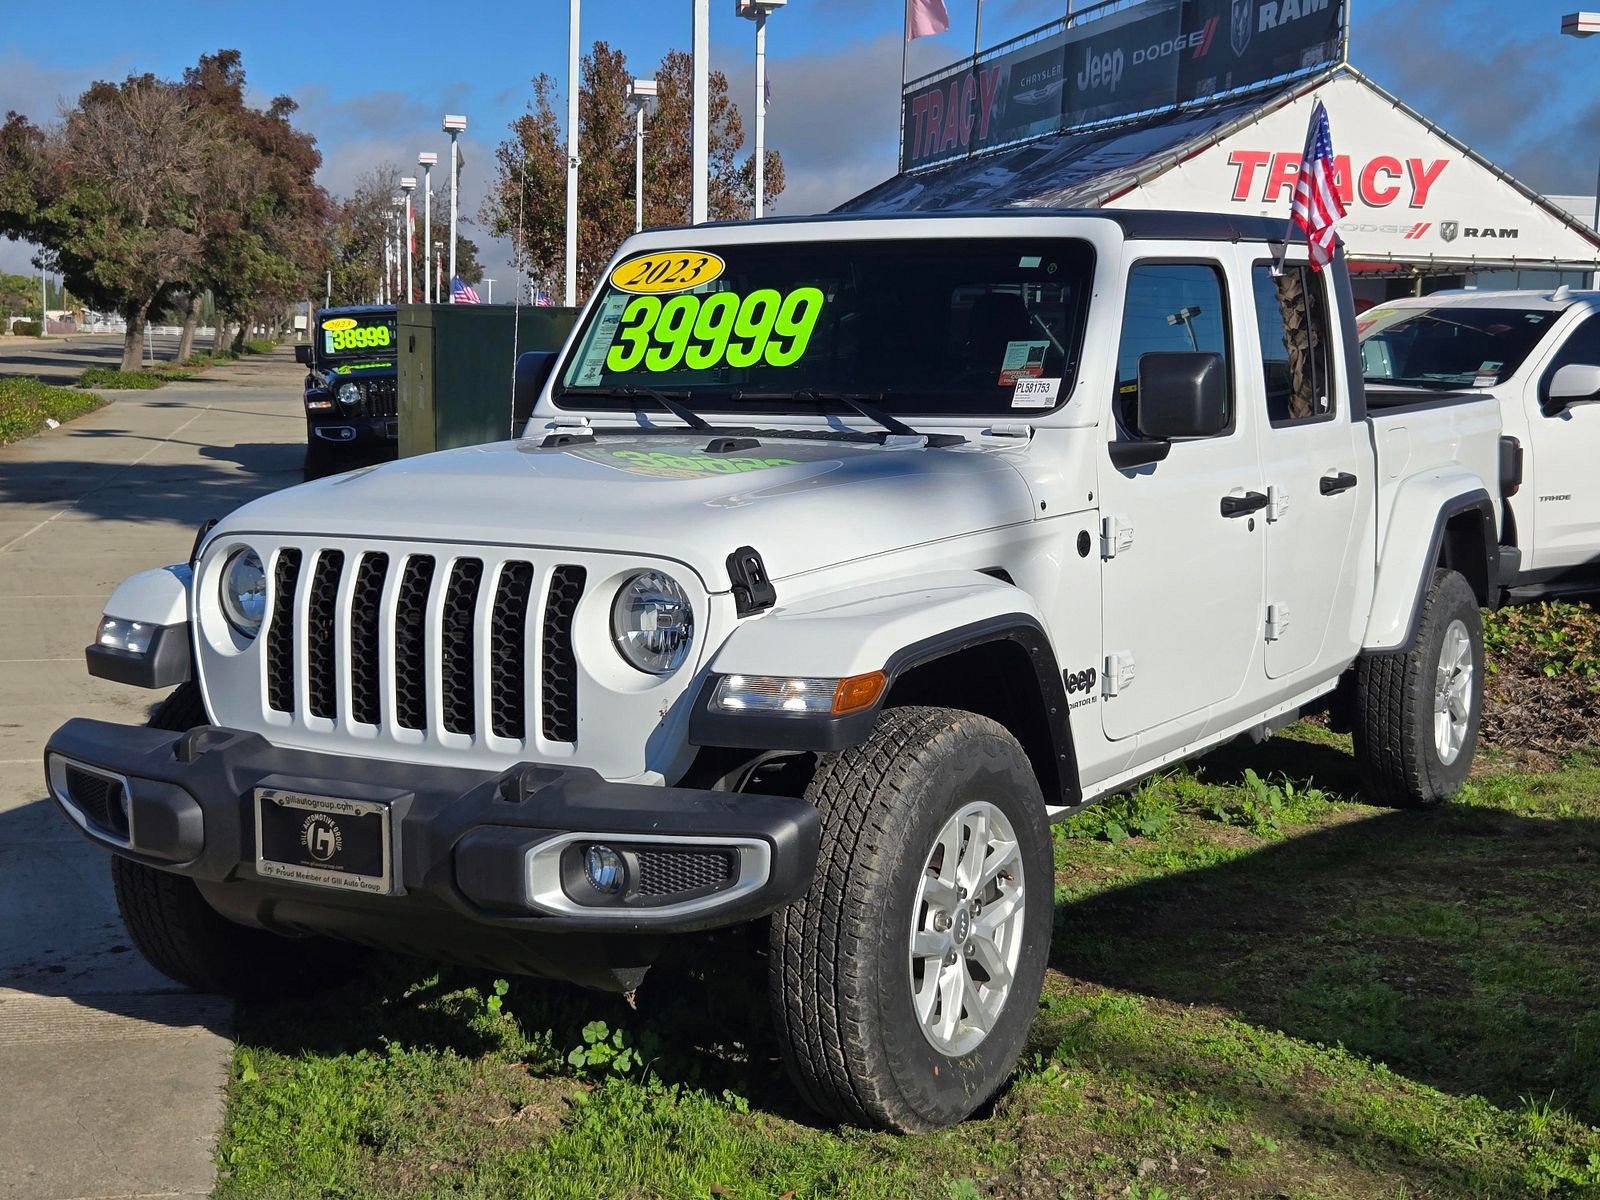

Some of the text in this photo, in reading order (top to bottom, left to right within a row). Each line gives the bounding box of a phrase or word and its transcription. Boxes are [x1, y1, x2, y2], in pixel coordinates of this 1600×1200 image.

[1259, 0, 1329, 32] RAM
[1132, 30, 1205, 65] DODGE
[1020, 64, 1062, 87] CHRYSLER
[1077, 47, 1124, 92] Jeep
[912, 65, 1000, 160] TRACY
[1342, 223, 1417, 233] ODGE
[1463, 227, 1519, 238] RAM
[624, 257, 709, 285] 2023
[332, 326, 390, 349] 38999
[606, 287, 825, 372] 39999
[1016, 383, 1050, 393] PL581753
[1538, 494, 1571, 502] TAHOE
[296, 871, 322, 881] Member
[343, 879, 359, 887] Auto
[360, 881, 381, 891] Group
